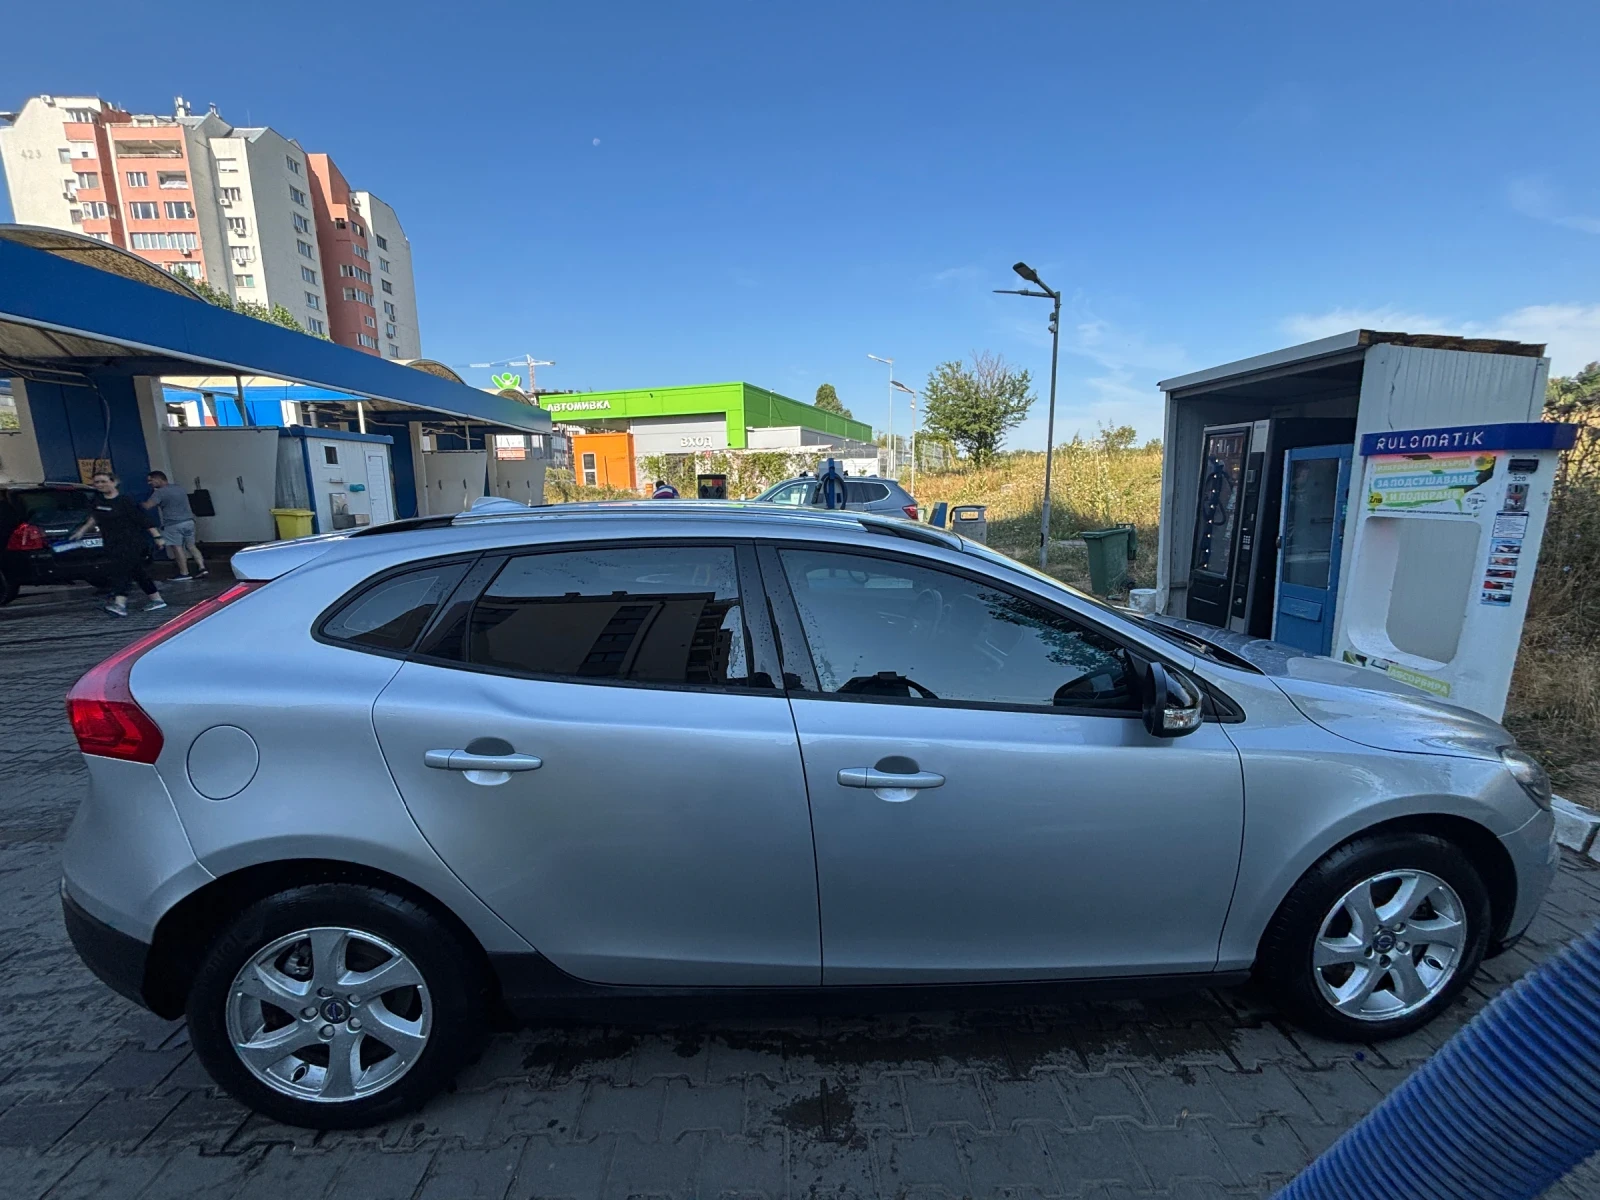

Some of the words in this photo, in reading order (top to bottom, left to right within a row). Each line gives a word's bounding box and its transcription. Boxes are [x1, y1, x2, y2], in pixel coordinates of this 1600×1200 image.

[547, 399, 611, 412] АВТОМИВКА
[680, 436, 713, 449] ВХОД
[1377, 479, 1389, 488] ЗА
[1390, 474, 1476, 488] ПОДСУШАВАНЕ
